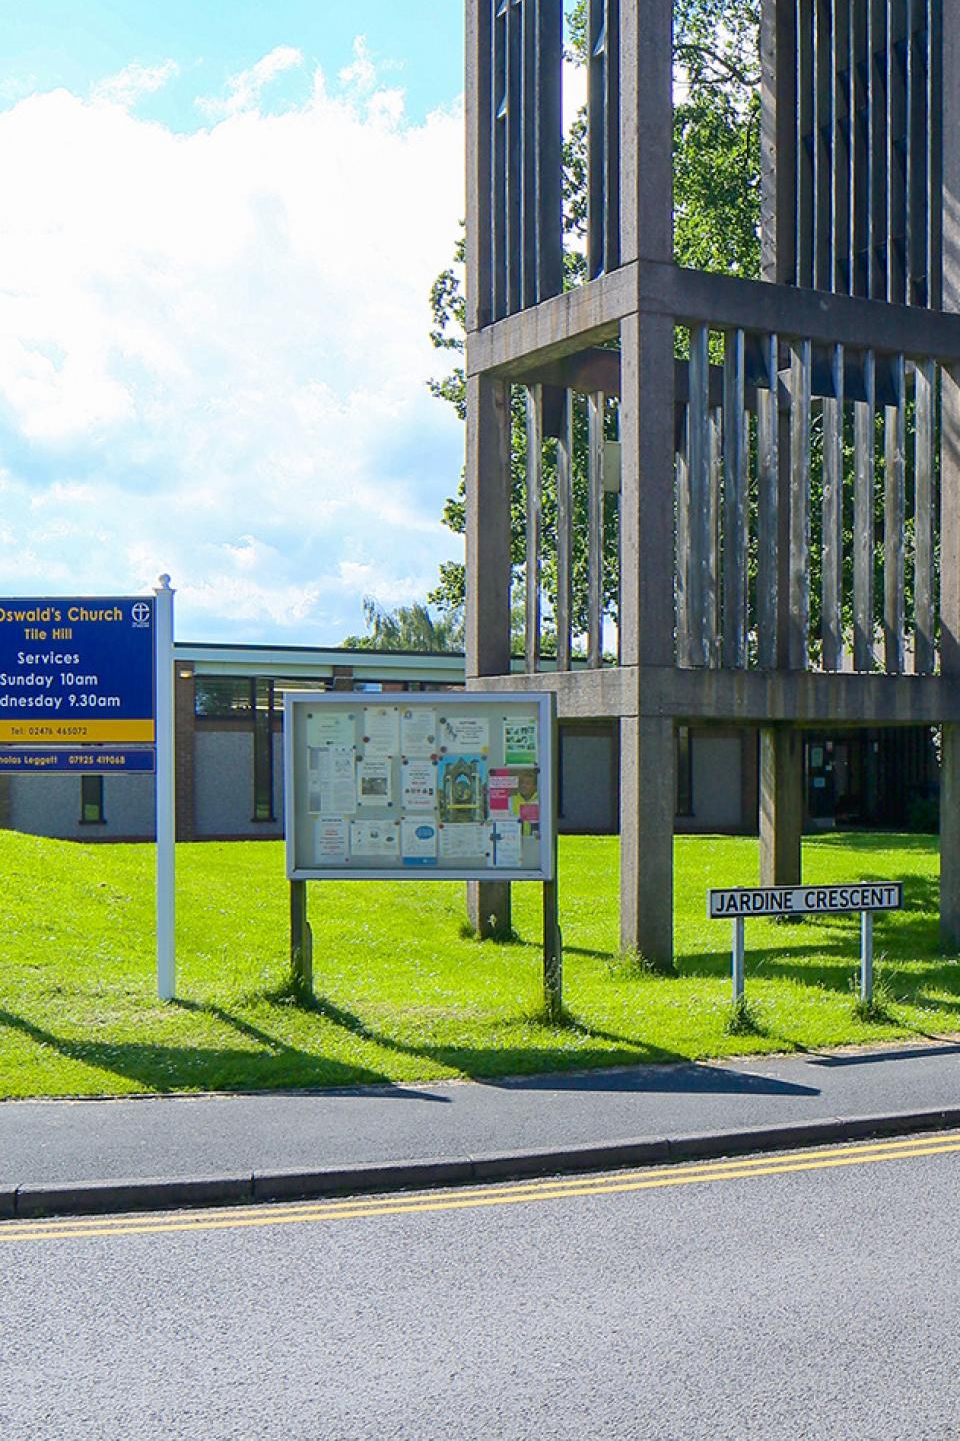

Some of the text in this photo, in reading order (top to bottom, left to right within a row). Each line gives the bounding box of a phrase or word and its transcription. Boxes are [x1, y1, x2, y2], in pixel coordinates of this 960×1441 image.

[68, 607, 123, 621] Church
[24, 628, 73, 640] Tile Hill
[17, 651, 80, 664] Services
[0, 673, 98, 688] Sunday 10am
[68, 694, 121, 707] 9.30am
[716, 888, 896, 913] JARDINE CRESCENT
